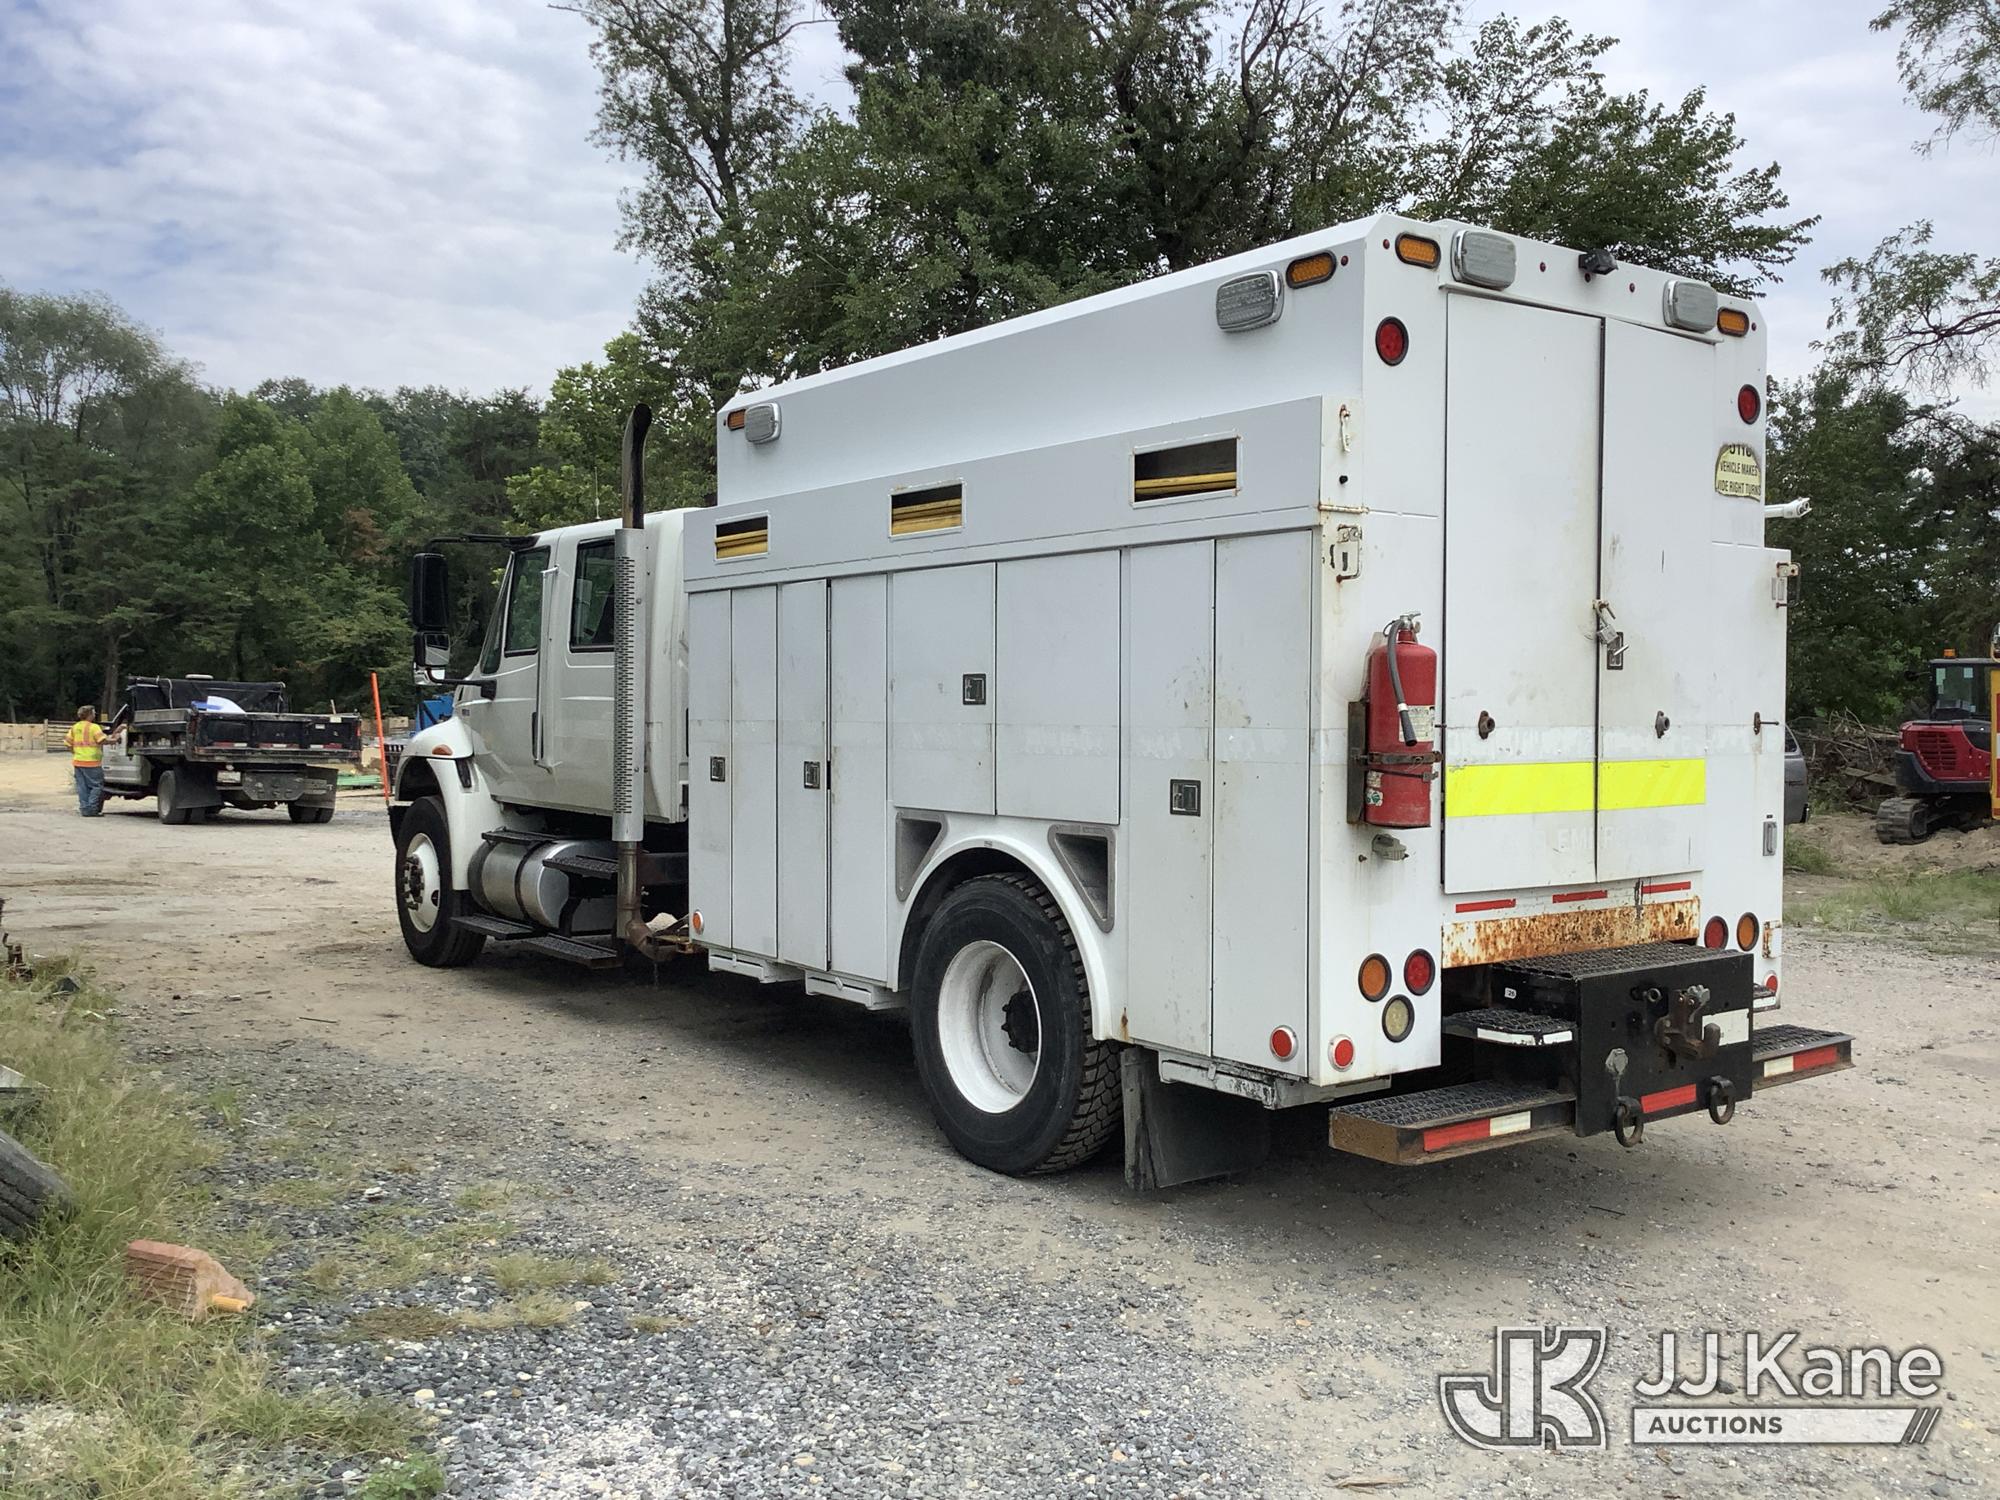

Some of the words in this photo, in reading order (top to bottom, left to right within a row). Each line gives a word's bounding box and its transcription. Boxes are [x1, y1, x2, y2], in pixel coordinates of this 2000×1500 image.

[1720, 460, 1741, 474] VEHICLE
[1742, 463, 1758, 476] MAKES
[1730, 480, 1745, 494] RIGHT
[1745, 483, 1761, 496] TURNS
